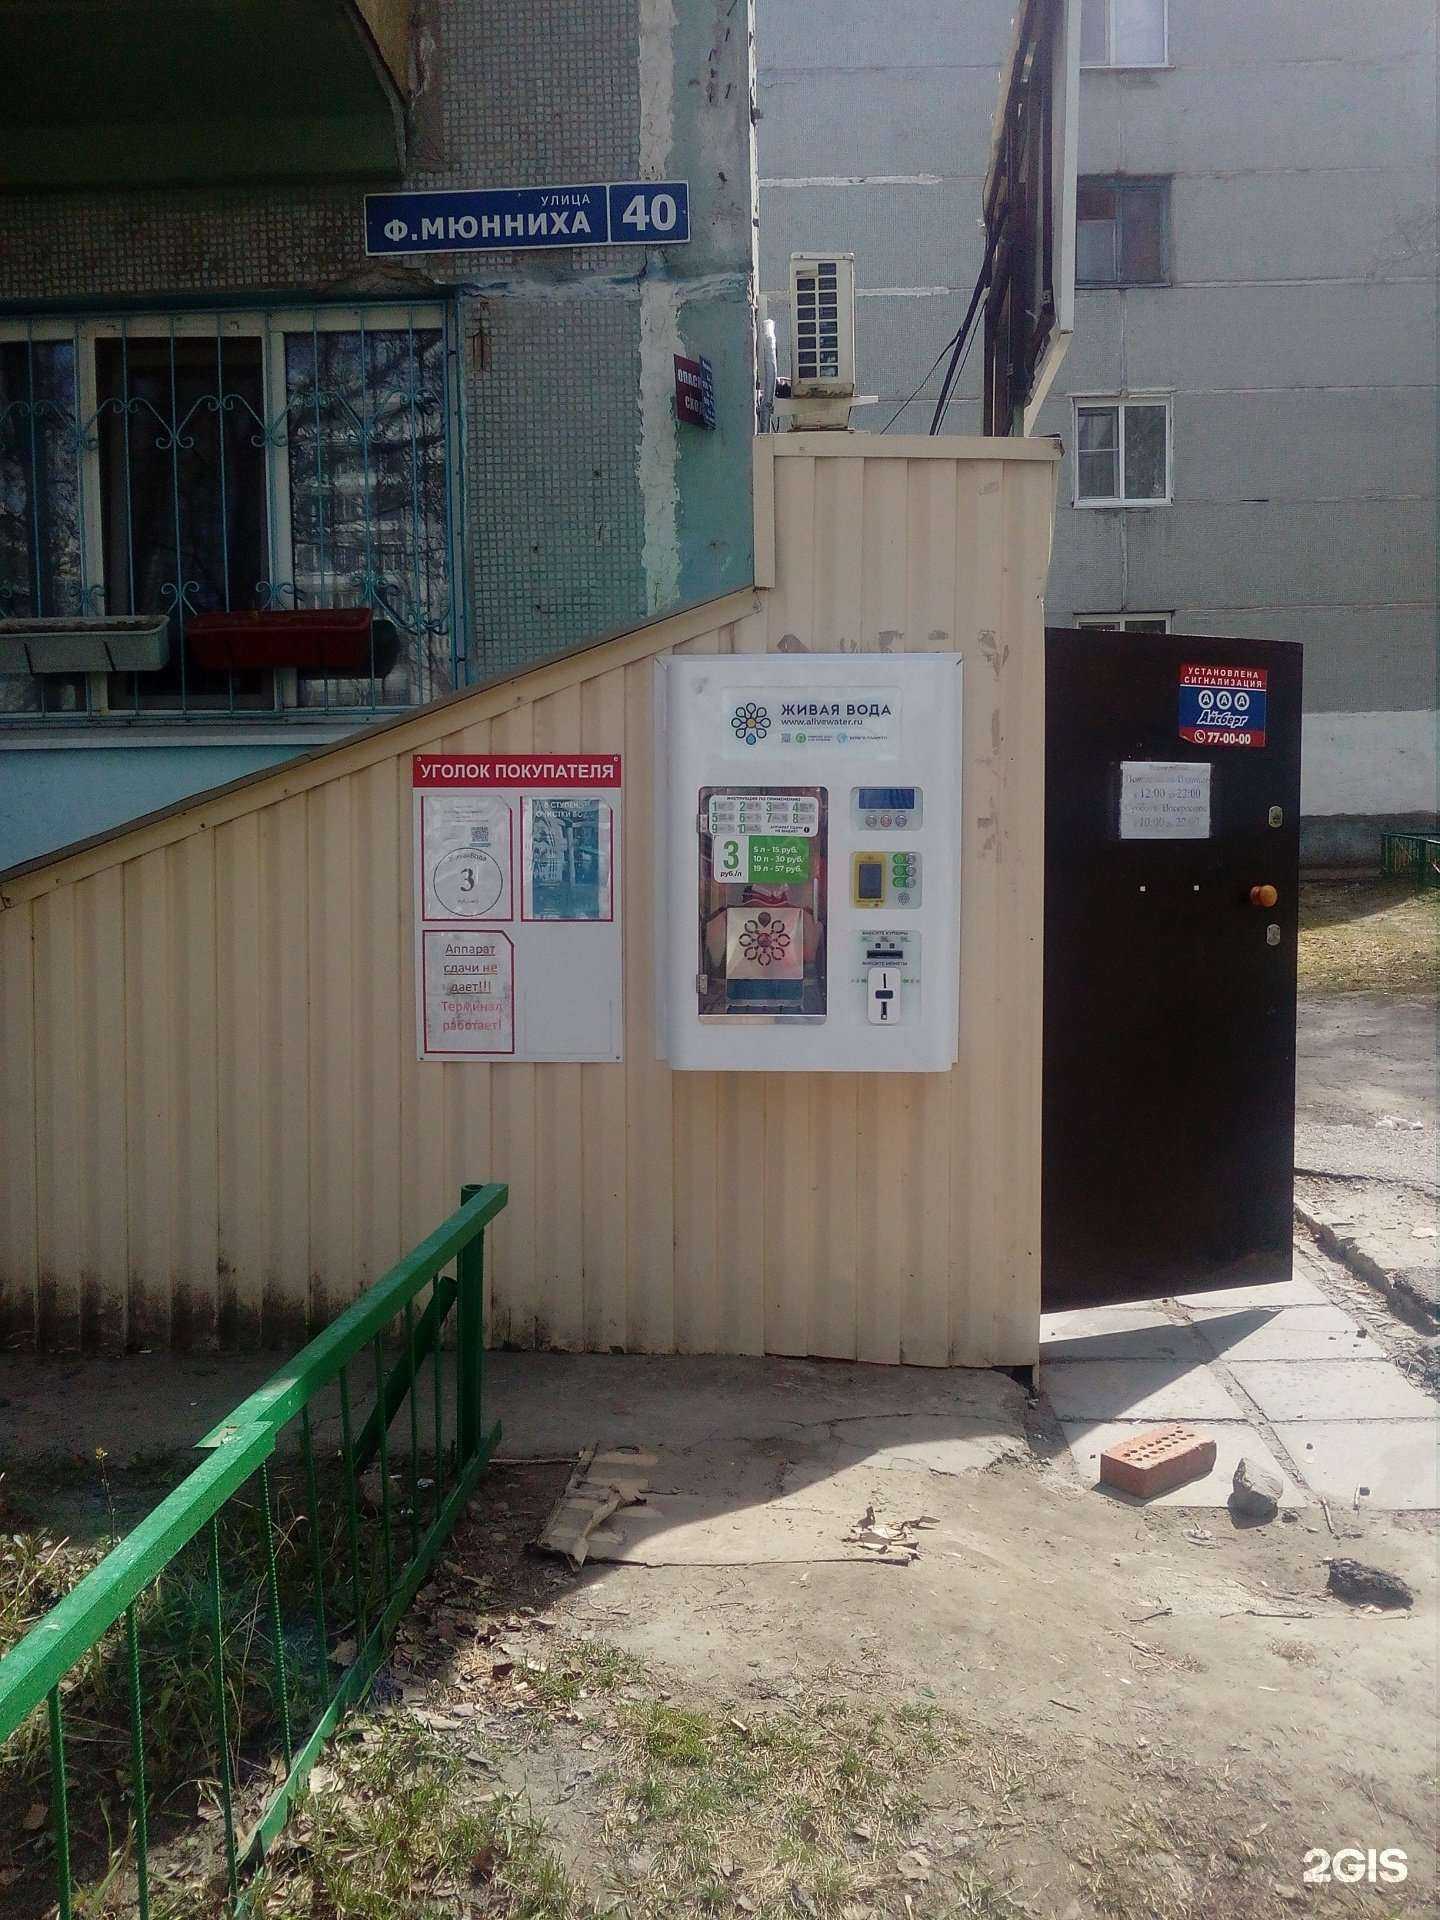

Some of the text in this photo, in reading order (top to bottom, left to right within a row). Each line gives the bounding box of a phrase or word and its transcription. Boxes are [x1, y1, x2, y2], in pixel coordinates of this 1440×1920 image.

[540, 192, 591, 207] УЛИЦА
[621, 193, 678, 232] 40
[383, 210, 592, 242] Ф.МЮННИХА
[1187, 666, 1259, 679] УСТАНОВЛЕНА
[1184, 676, 1263, 688] СИГНАЛИЗАЦИЯ
[780, 704, 892, 718] ЖИВАЯ ВОДА
[780, 718, 863, 727] www.alivewater.ru
[1196, 709, 1249, 728] Айсберг
[1207, 732, 1251, 744] 77-00-00
[420, 764, 614, 778] УГОЛОК ПОКУПАТЕЛЯ
[722, 840, 739, 870] 3
[460, 867, 475, 892] 3
[445, 943, 496, 955] Аппарат
[443, 963, 497, 975] сдачи не
[440, 1001, 503, 1013] Терминал
[443, 1018, 502, 1032] работает!
